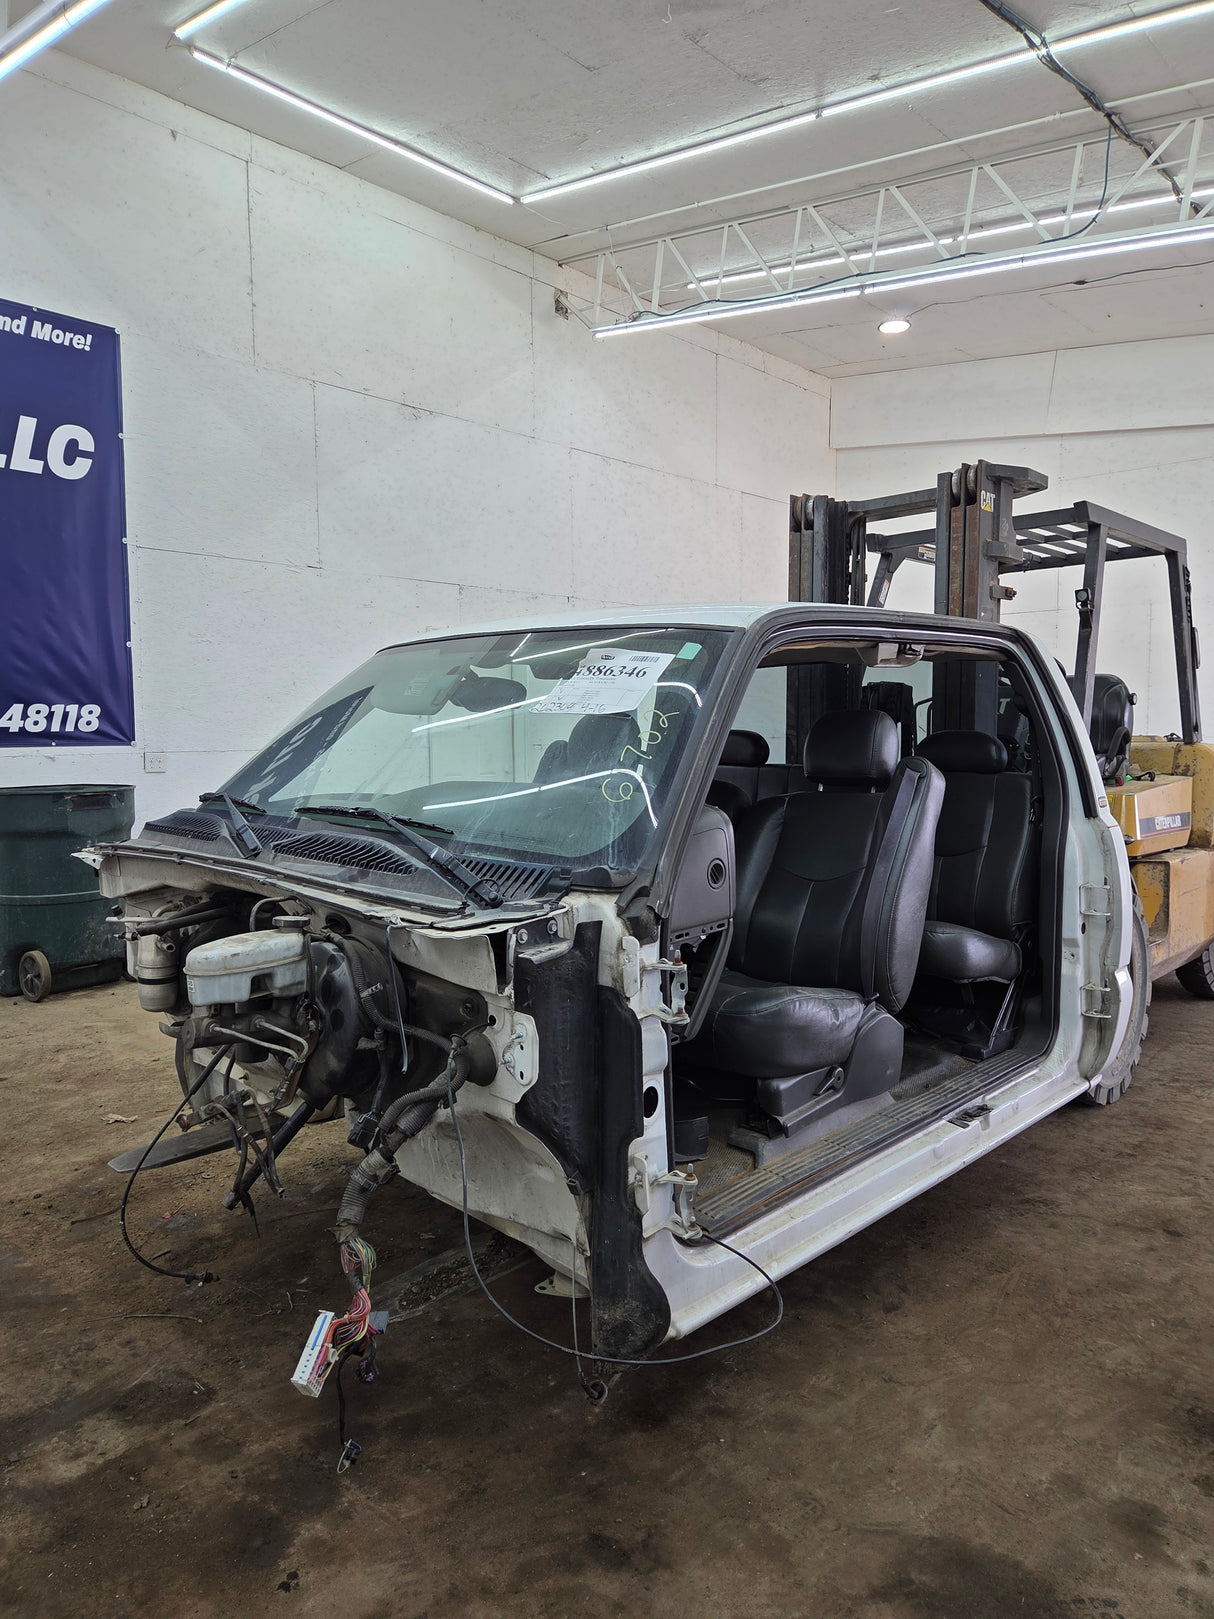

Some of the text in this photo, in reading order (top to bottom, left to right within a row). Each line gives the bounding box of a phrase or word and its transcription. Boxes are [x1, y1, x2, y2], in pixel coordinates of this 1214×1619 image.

[31, 320, 93, 352] More!
[0, 415, 95, 480] LC
[980, 490, 996, 513] CAT
[0, 703, 101, 733] 48118
